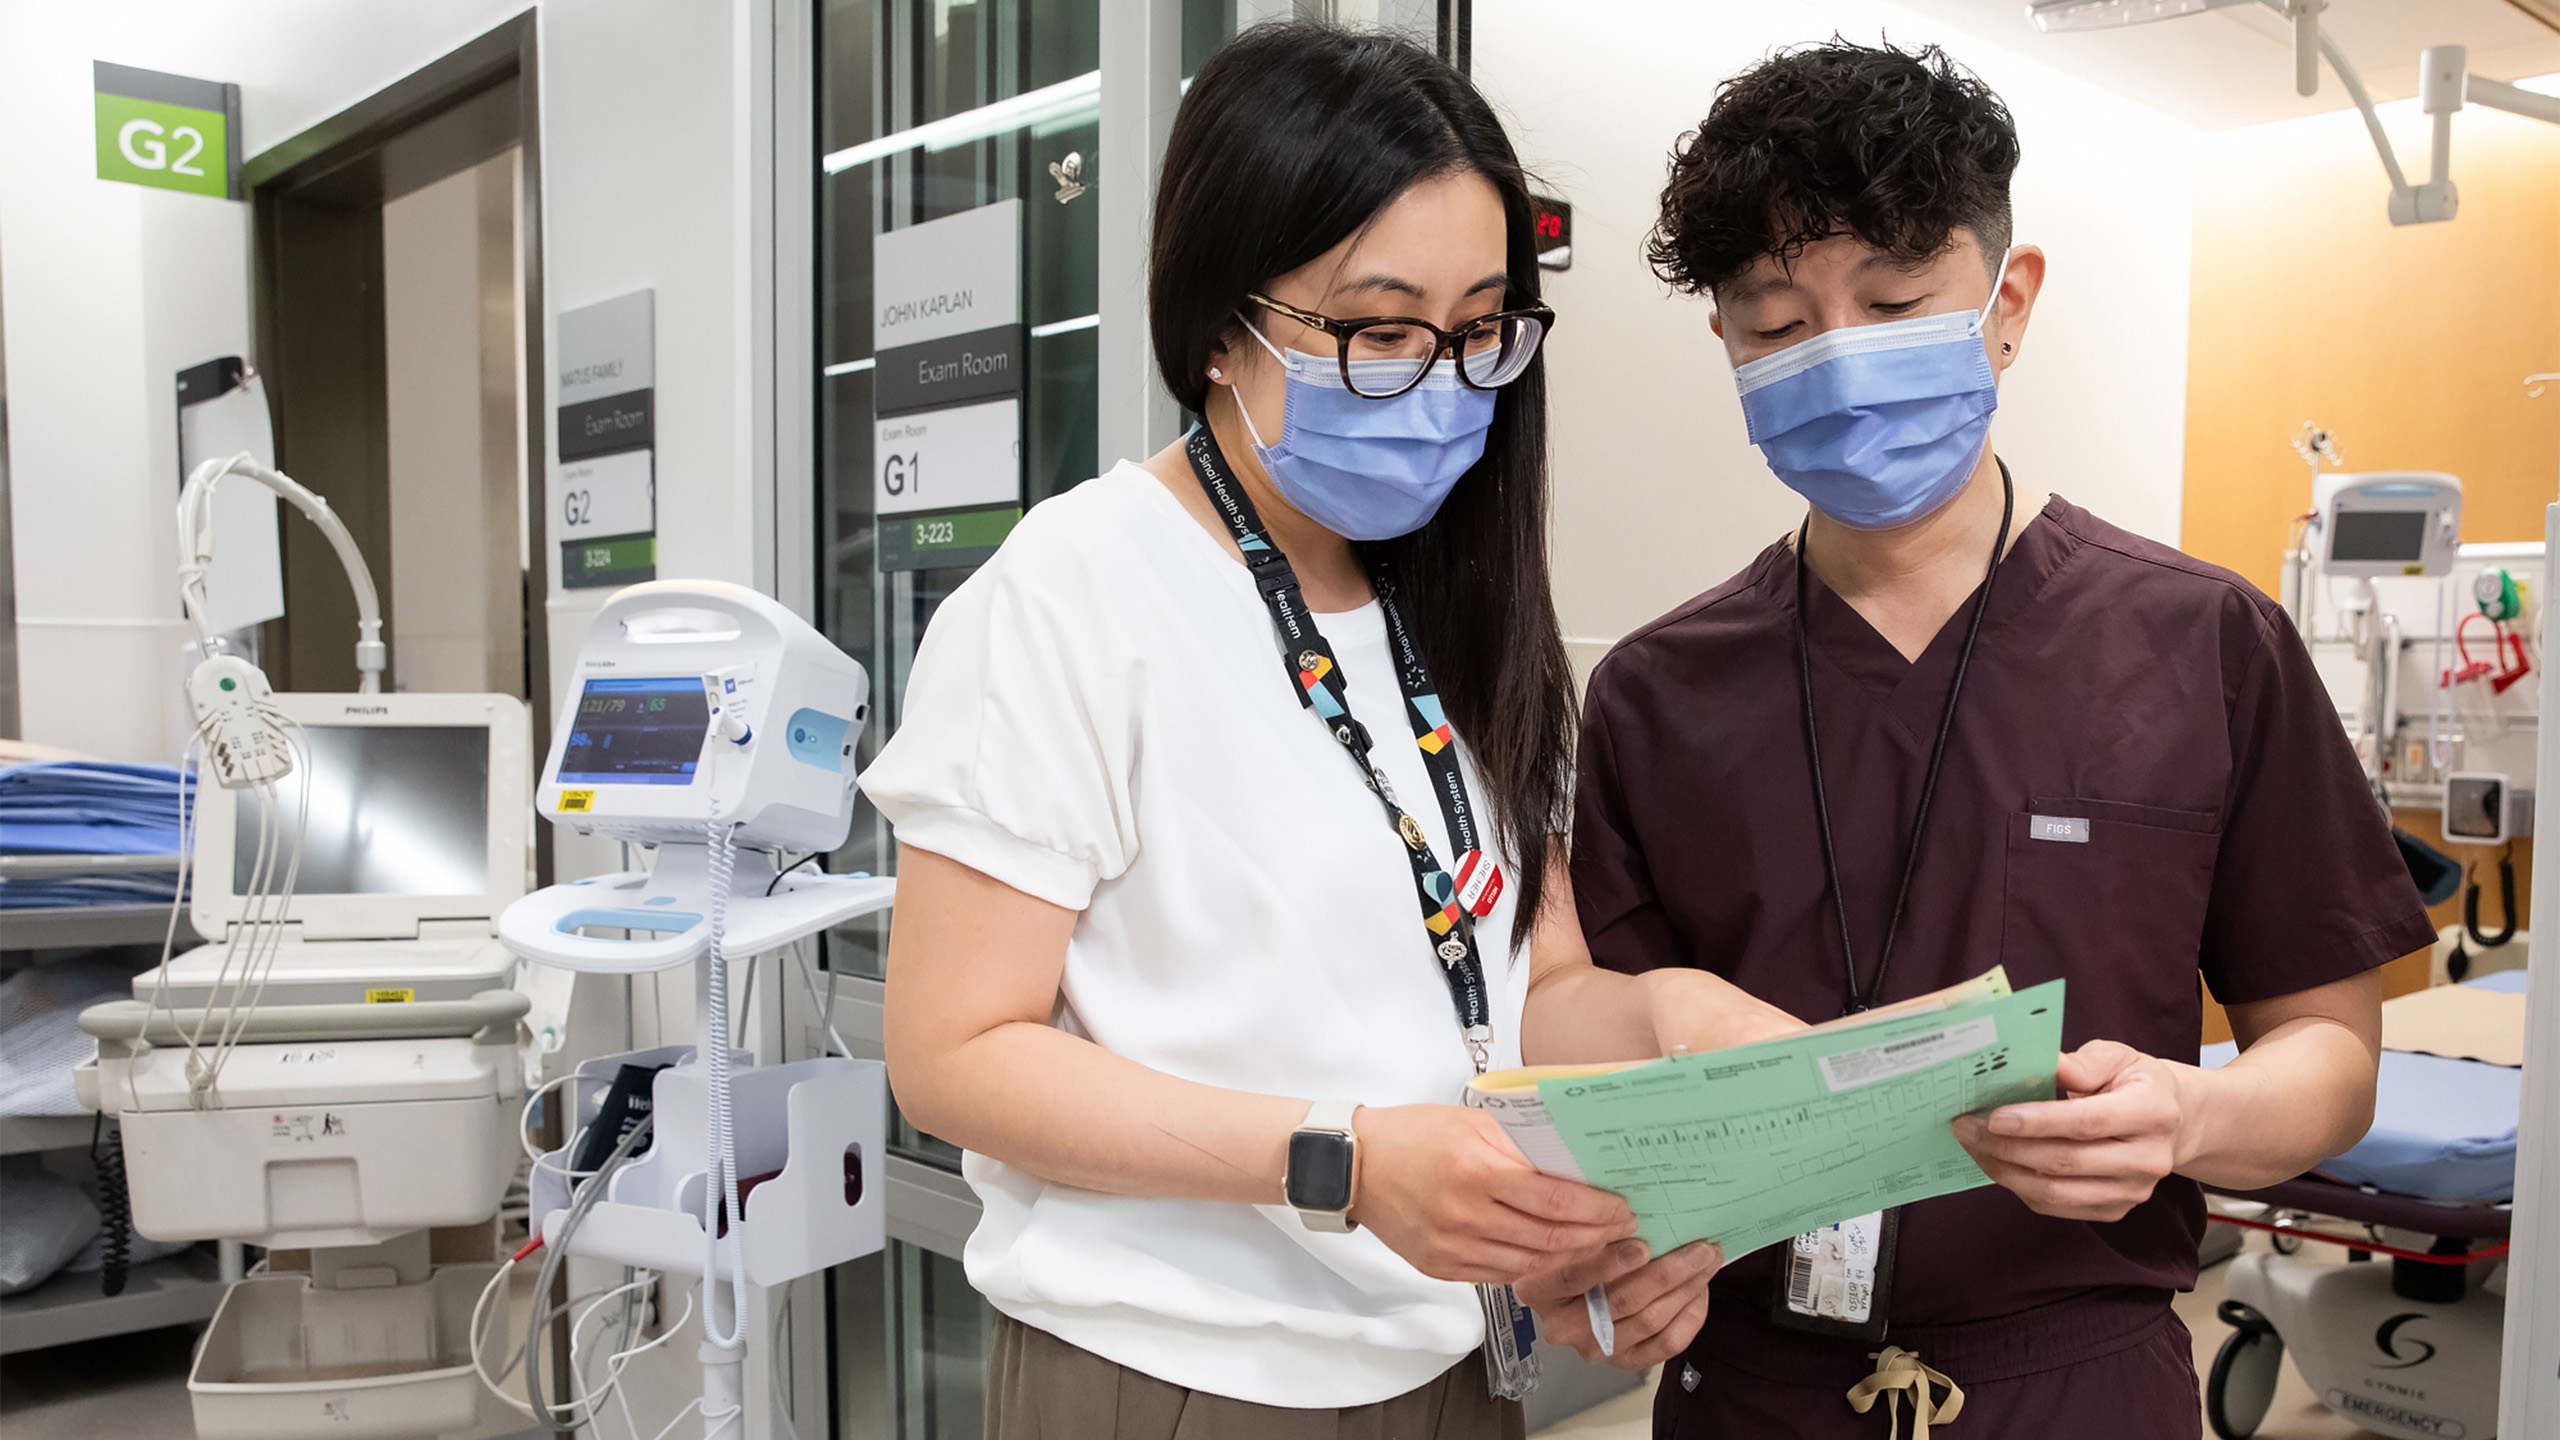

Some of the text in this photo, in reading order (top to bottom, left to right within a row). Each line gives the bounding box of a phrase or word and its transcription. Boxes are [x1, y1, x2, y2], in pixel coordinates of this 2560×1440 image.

[118, 118, 205, 177] G2
[1537, 212, 1561, 237] 20
[880, 288, 973, 328] JOHN KAPLAN
[919, 352, 1008, 385] Exam Room
[882, 424, 928, 441] Exam Room
[883, 451, 919, 497] G1
[1198, 452, 1219, 481] Sinai
[1211, 475, 1240, 517] Health
[564, 489, 592, 526] G2
[915, 521, 955, 545] 3-223
[1387, 599, 1416, 665] Sinai Health
[345, 705, 388, 716] PHILIPS
[650, 698, 667, 712] 65
[1445, 770, 1466, 815] System
[2046, 823, 2072, 835] FIGS
[1486, 885, 1499, 905] HELLO
[1466, 985, 1480, 1025] Health
[2341, 1393, 2444, 1435] EMERGENCY
